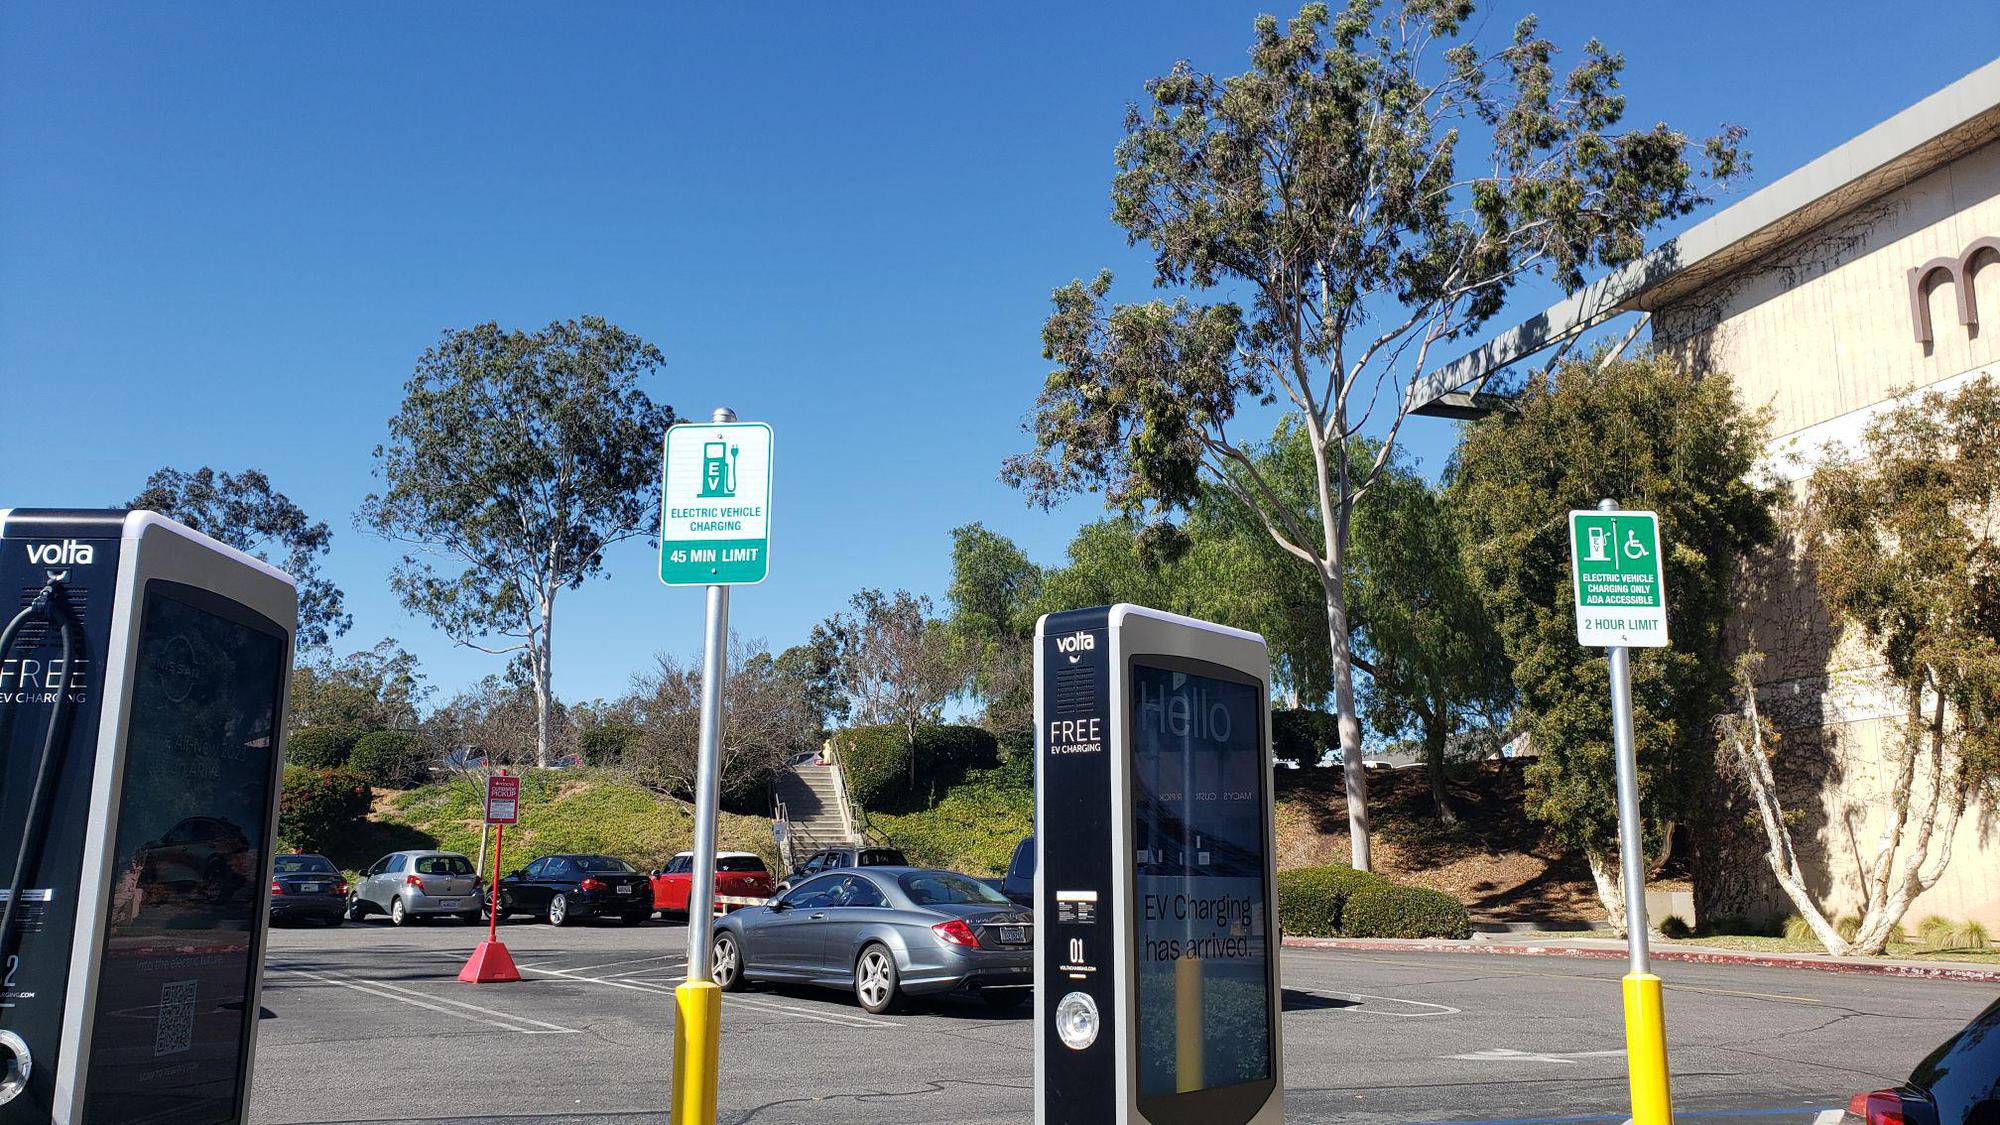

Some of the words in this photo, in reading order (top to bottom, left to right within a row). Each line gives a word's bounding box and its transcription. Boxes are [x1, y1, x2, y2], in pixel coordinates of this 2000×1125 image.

[671, 508, 718, 518] ELECTRIC
[721, 507, 761, 517] VEHICLE
[690, 521, 742, 532] CHARGING
[26, 539, 94, 565] volta
[670, 550, 687, 563] 45
[690, 549, 716, 563] MIN
[722, 548, 759, 562] LIMIT
[1583, 573, 1620, 583] ELECTRIC
[1621, 573, 1654, 583] VEHICLE
[1587, 584, 1628, 593] CHARGING
[1630, 585, 1650, 594] ONLY
[1587, 595, 1604, 604] ADA
[1605, 595, 1654, 605] ACCESSIBLE
[1585, 619, 1592, 630] 2
[1595, 619, 1625, 631] HOUR
[1629, 619, 1659, 631] LIMIT
[1056, 631, 1095, 653] volta
[1142, 680, 1231, 742] Hello
[1051, 718, 1101, 743] FREE
[1051, 745, 1061, 755] EV
[1061, 743, 1101, 754] CHARGING
[492, 790, 516, 798] PICKUP
[1145, 894, 1168, 921] EV
[1174, 893, 1251, 927] Charging
[1069, 938, 1085, 963] 01
[1146, 934, 1180, 961] has
[1186, 932, 1251, 960] arrived.
